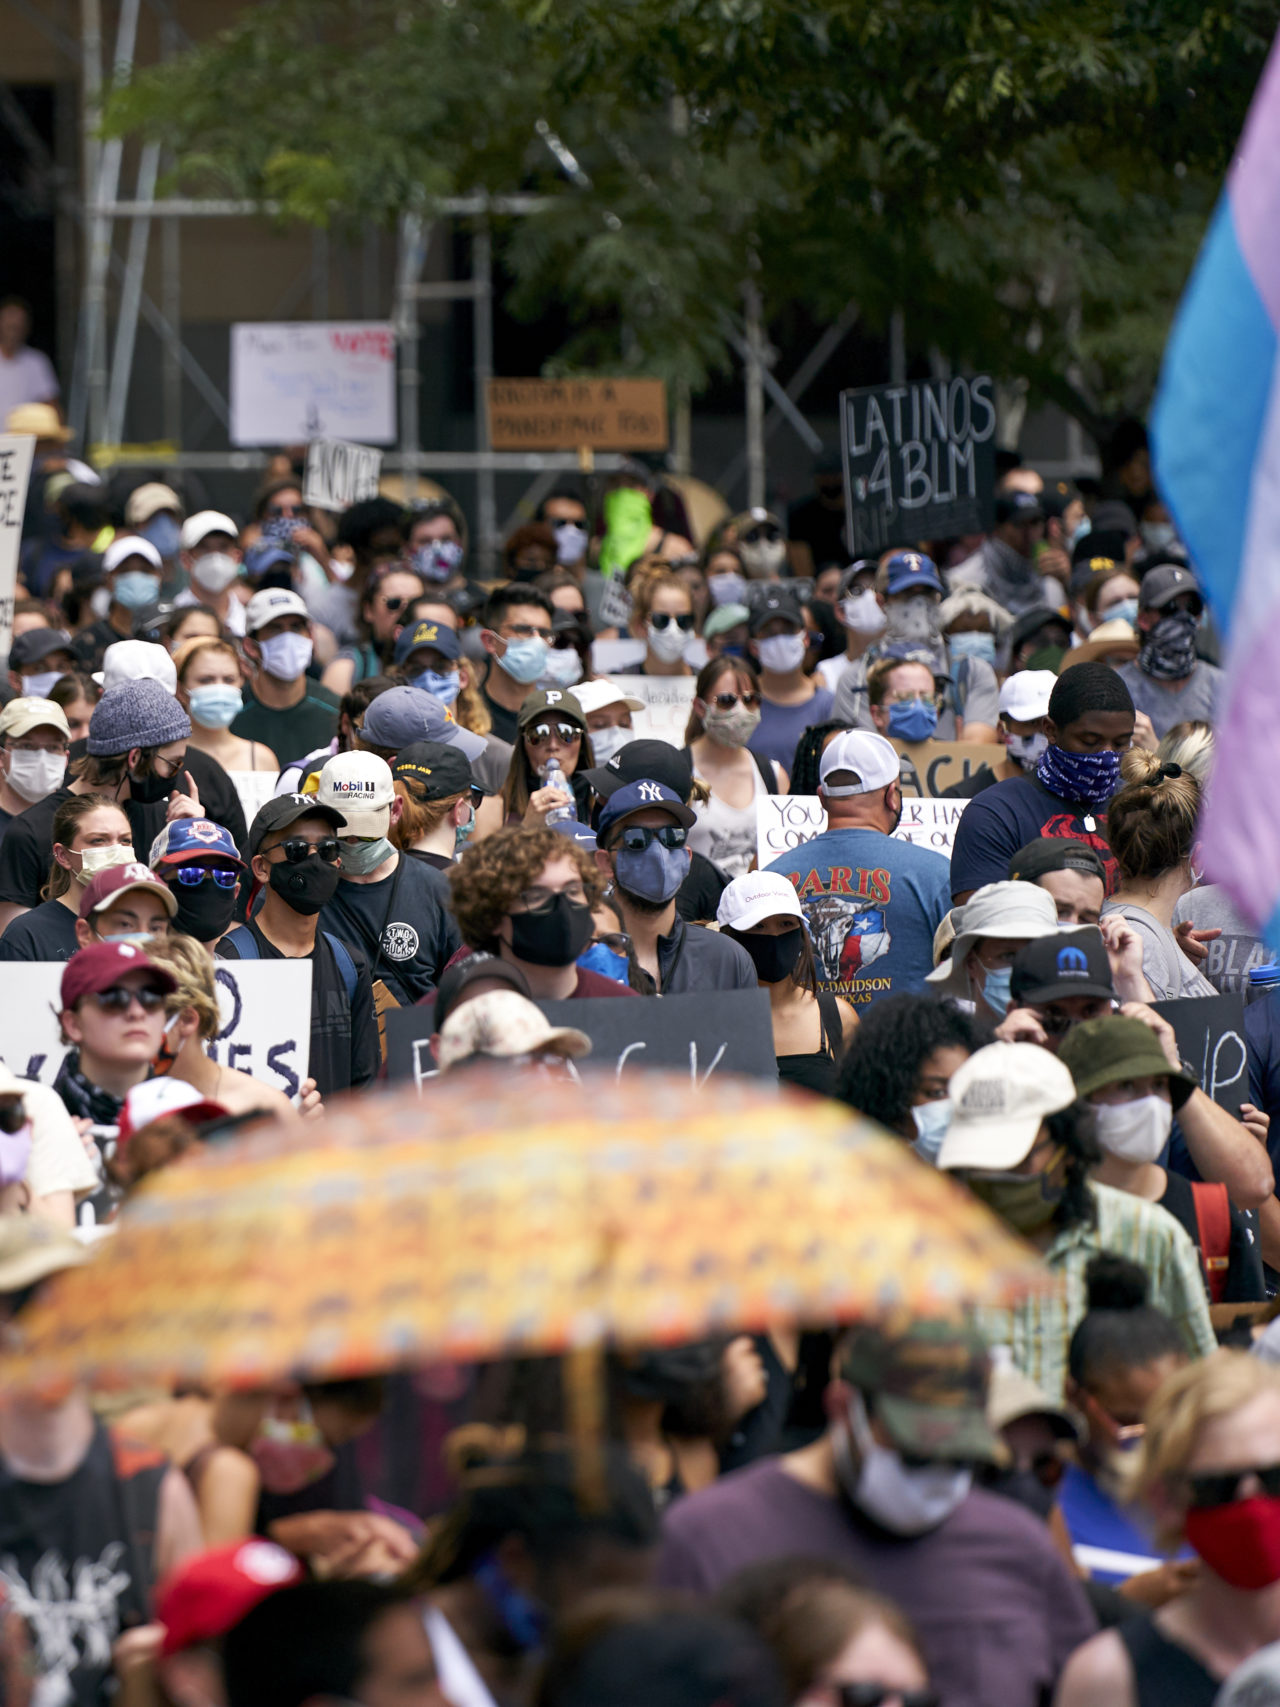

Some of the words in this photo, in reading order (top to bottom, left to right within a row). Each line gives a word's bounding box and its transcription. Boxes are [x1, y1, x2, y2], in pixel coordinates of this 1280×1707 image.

[847, 375, 996, 457] LATINOS
[869, 443, 893, 511] 4
[898, 438, 976, 509] BLM
[333, 781, 363, 792] Mobil
[771, 799, 825, 827] YOU
